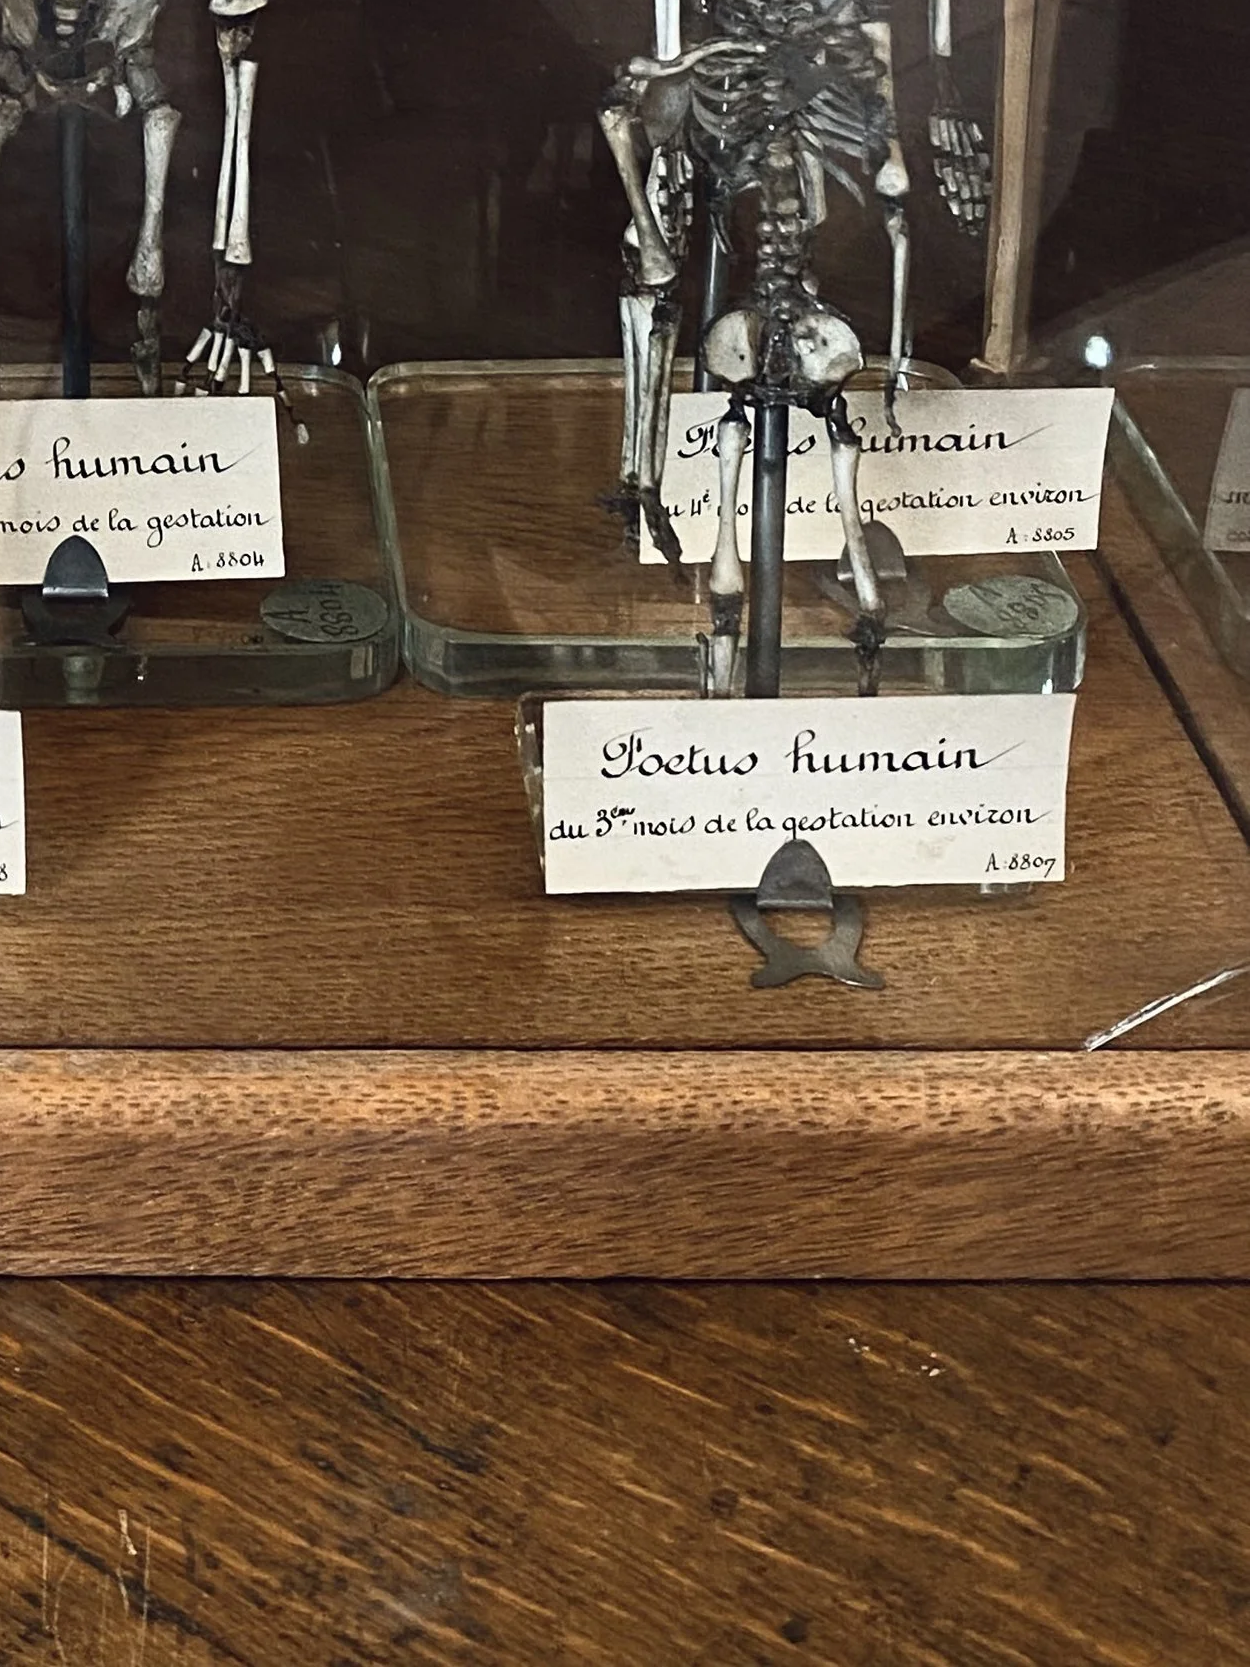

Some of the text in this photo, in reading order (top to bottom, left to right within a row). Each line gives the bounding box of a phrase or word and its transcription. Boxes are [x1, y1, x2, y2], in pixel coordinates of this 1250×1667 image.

[46, 436, 258, 481] humain
[786, 496, 816, 514] de
[860, 488, 984, 521] gestation
[989, 481, 1100, 507] environ
[72, 514, 100, 533] de
[108, 508, 138, 532] la
[146, 505, 274, 549] gestation
[785, 729, 1026, 775] humain
[549, 819, 589, 840] du
[633, 815, 696, 837] mois
[703, 813, 738, 834] de
[745, 807, 776, 832] la
[782, 804, 917, 841] gestation
[927, 803, 1053, 827] environ
